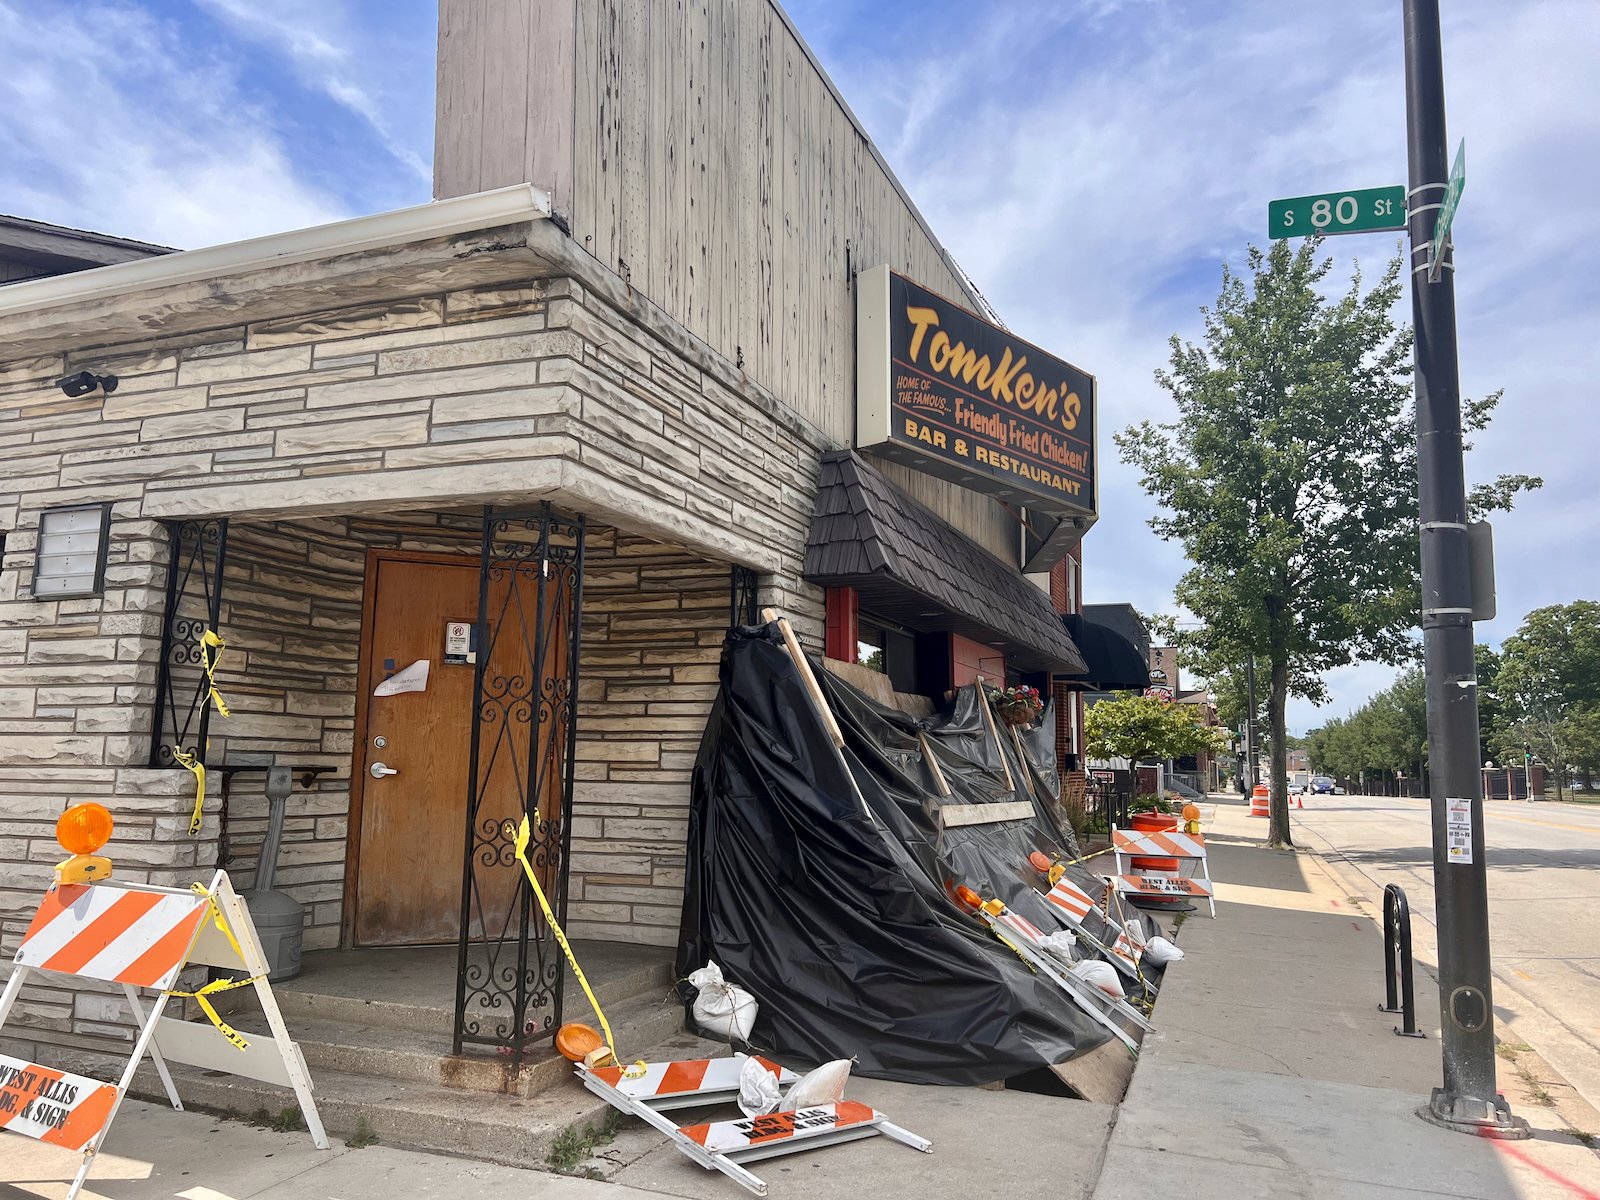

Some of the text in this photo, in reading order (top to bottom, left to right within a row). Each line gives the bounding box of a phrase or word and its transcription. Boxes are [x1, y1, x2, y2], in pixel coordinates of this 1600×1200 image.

[1283, 196, 1393, 228] S 80 St
[896, 375, 932, 391] HOME OF
[898, 391, 912, 404] THE
[954, 397, 1089, 474] Friendly Fried Chicken!
[905, 418, 1081, 496] BAR & RESTAURANT
[33, 1076, 79, 1105] ALLIS
[20, 1099, 35, 1119] &
[32, 1102, 70, 1130] SIGN
[733, 1109, 827, 1130] WEST ALLIS
